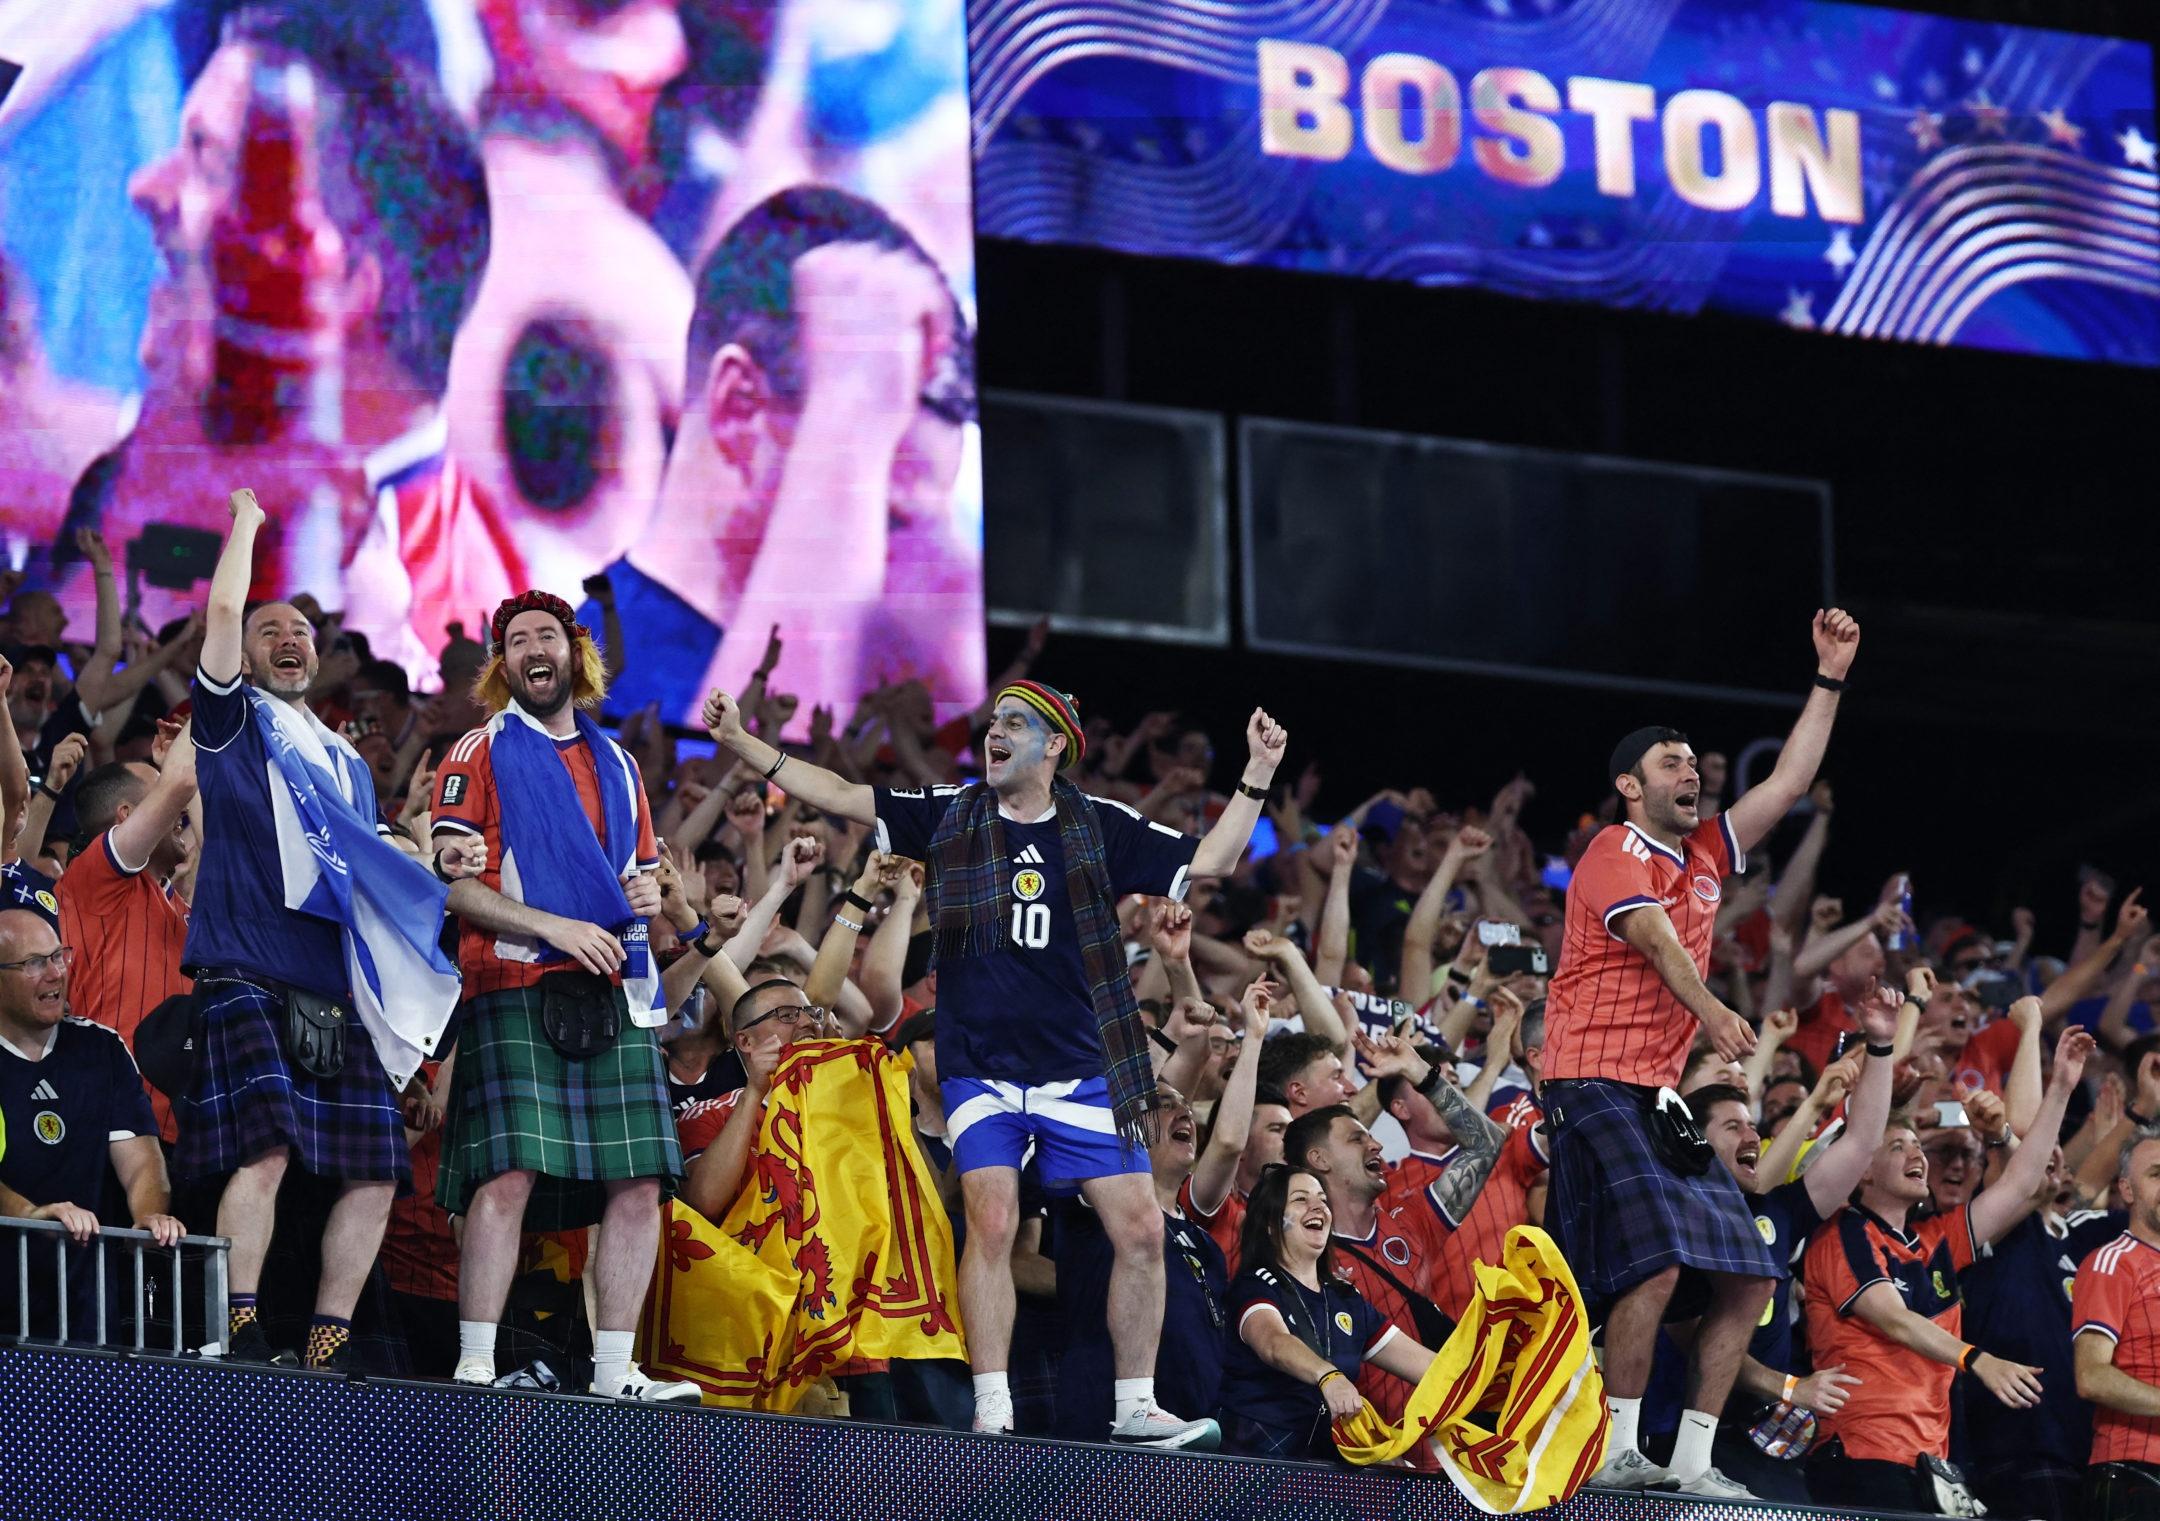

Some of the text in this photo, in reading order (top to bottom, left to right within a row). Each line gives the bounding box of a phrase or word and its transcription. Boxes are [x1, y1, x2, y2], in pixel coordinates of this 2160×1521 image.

[1256, 37, 1865, 224] BOSTON
[626, 923, 647, 932] BUD
[1012, 903, 1050, 949] 10
